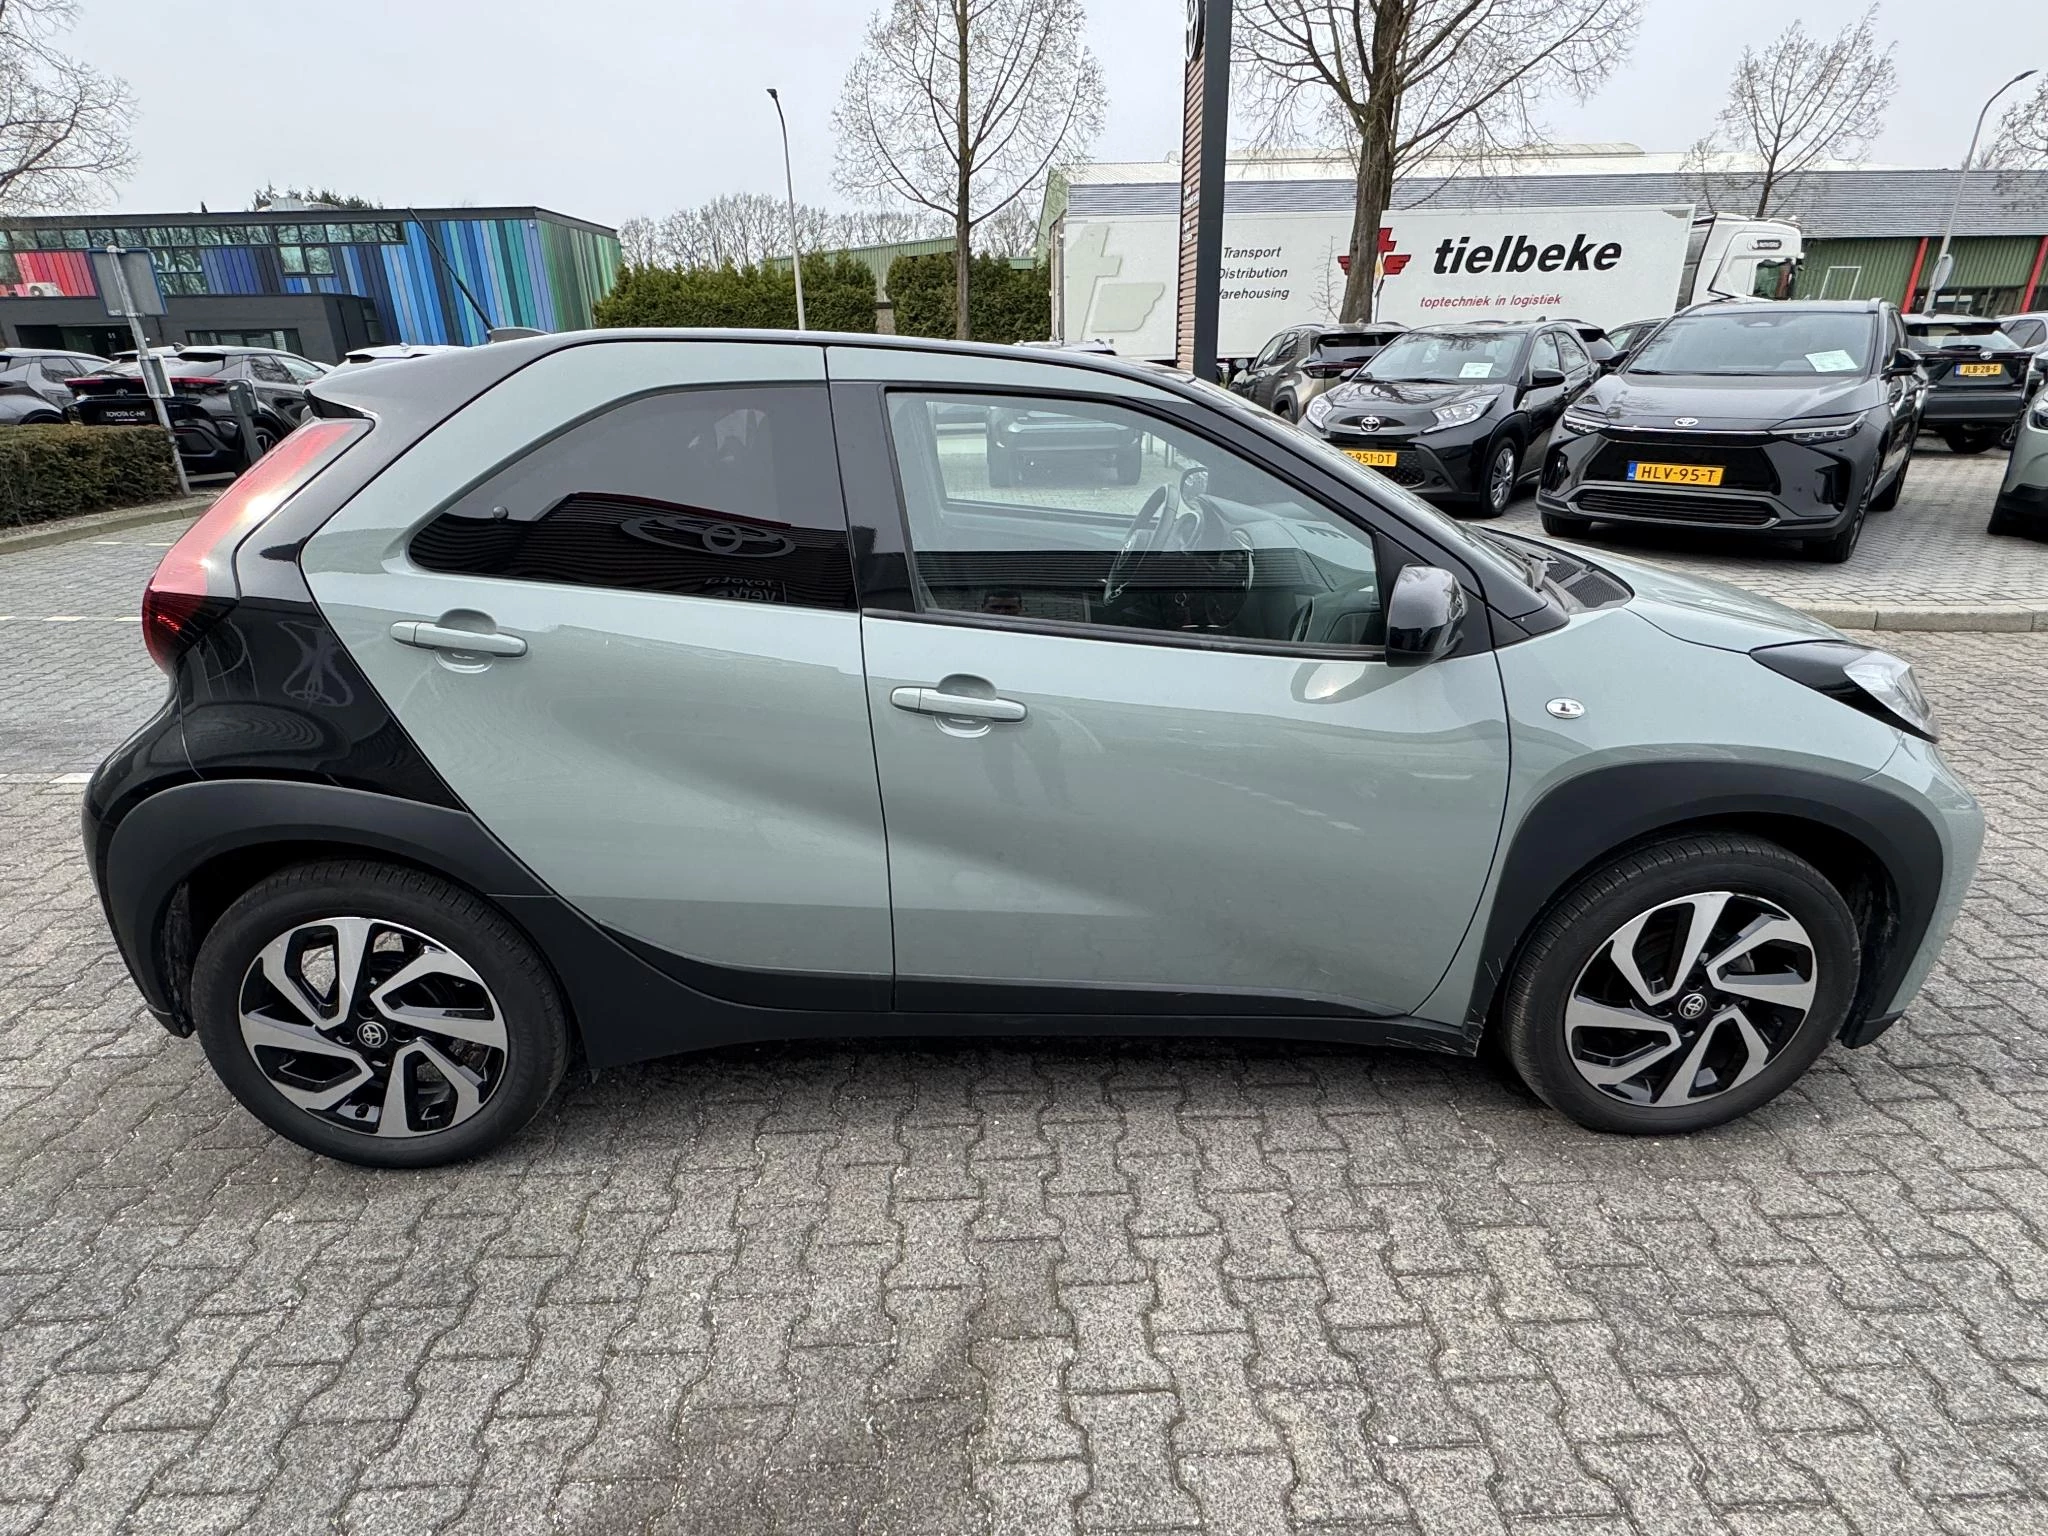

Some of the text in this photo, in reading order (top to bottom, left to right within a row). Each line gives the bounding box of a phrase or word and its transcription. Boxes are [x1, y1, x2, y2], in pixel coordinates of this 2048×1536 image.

[1223, 246, 1282, 260] Transport
[1433, 233, 1622, 275] tielbeke
[1219, 267, 1288, 279] Distribution
[1218, 286, 1290, 301] arehousing
[1419, 293, 1562, 310] toptechniek in logistiek
[1641, 465, 1717, 483] HLV-95-T
